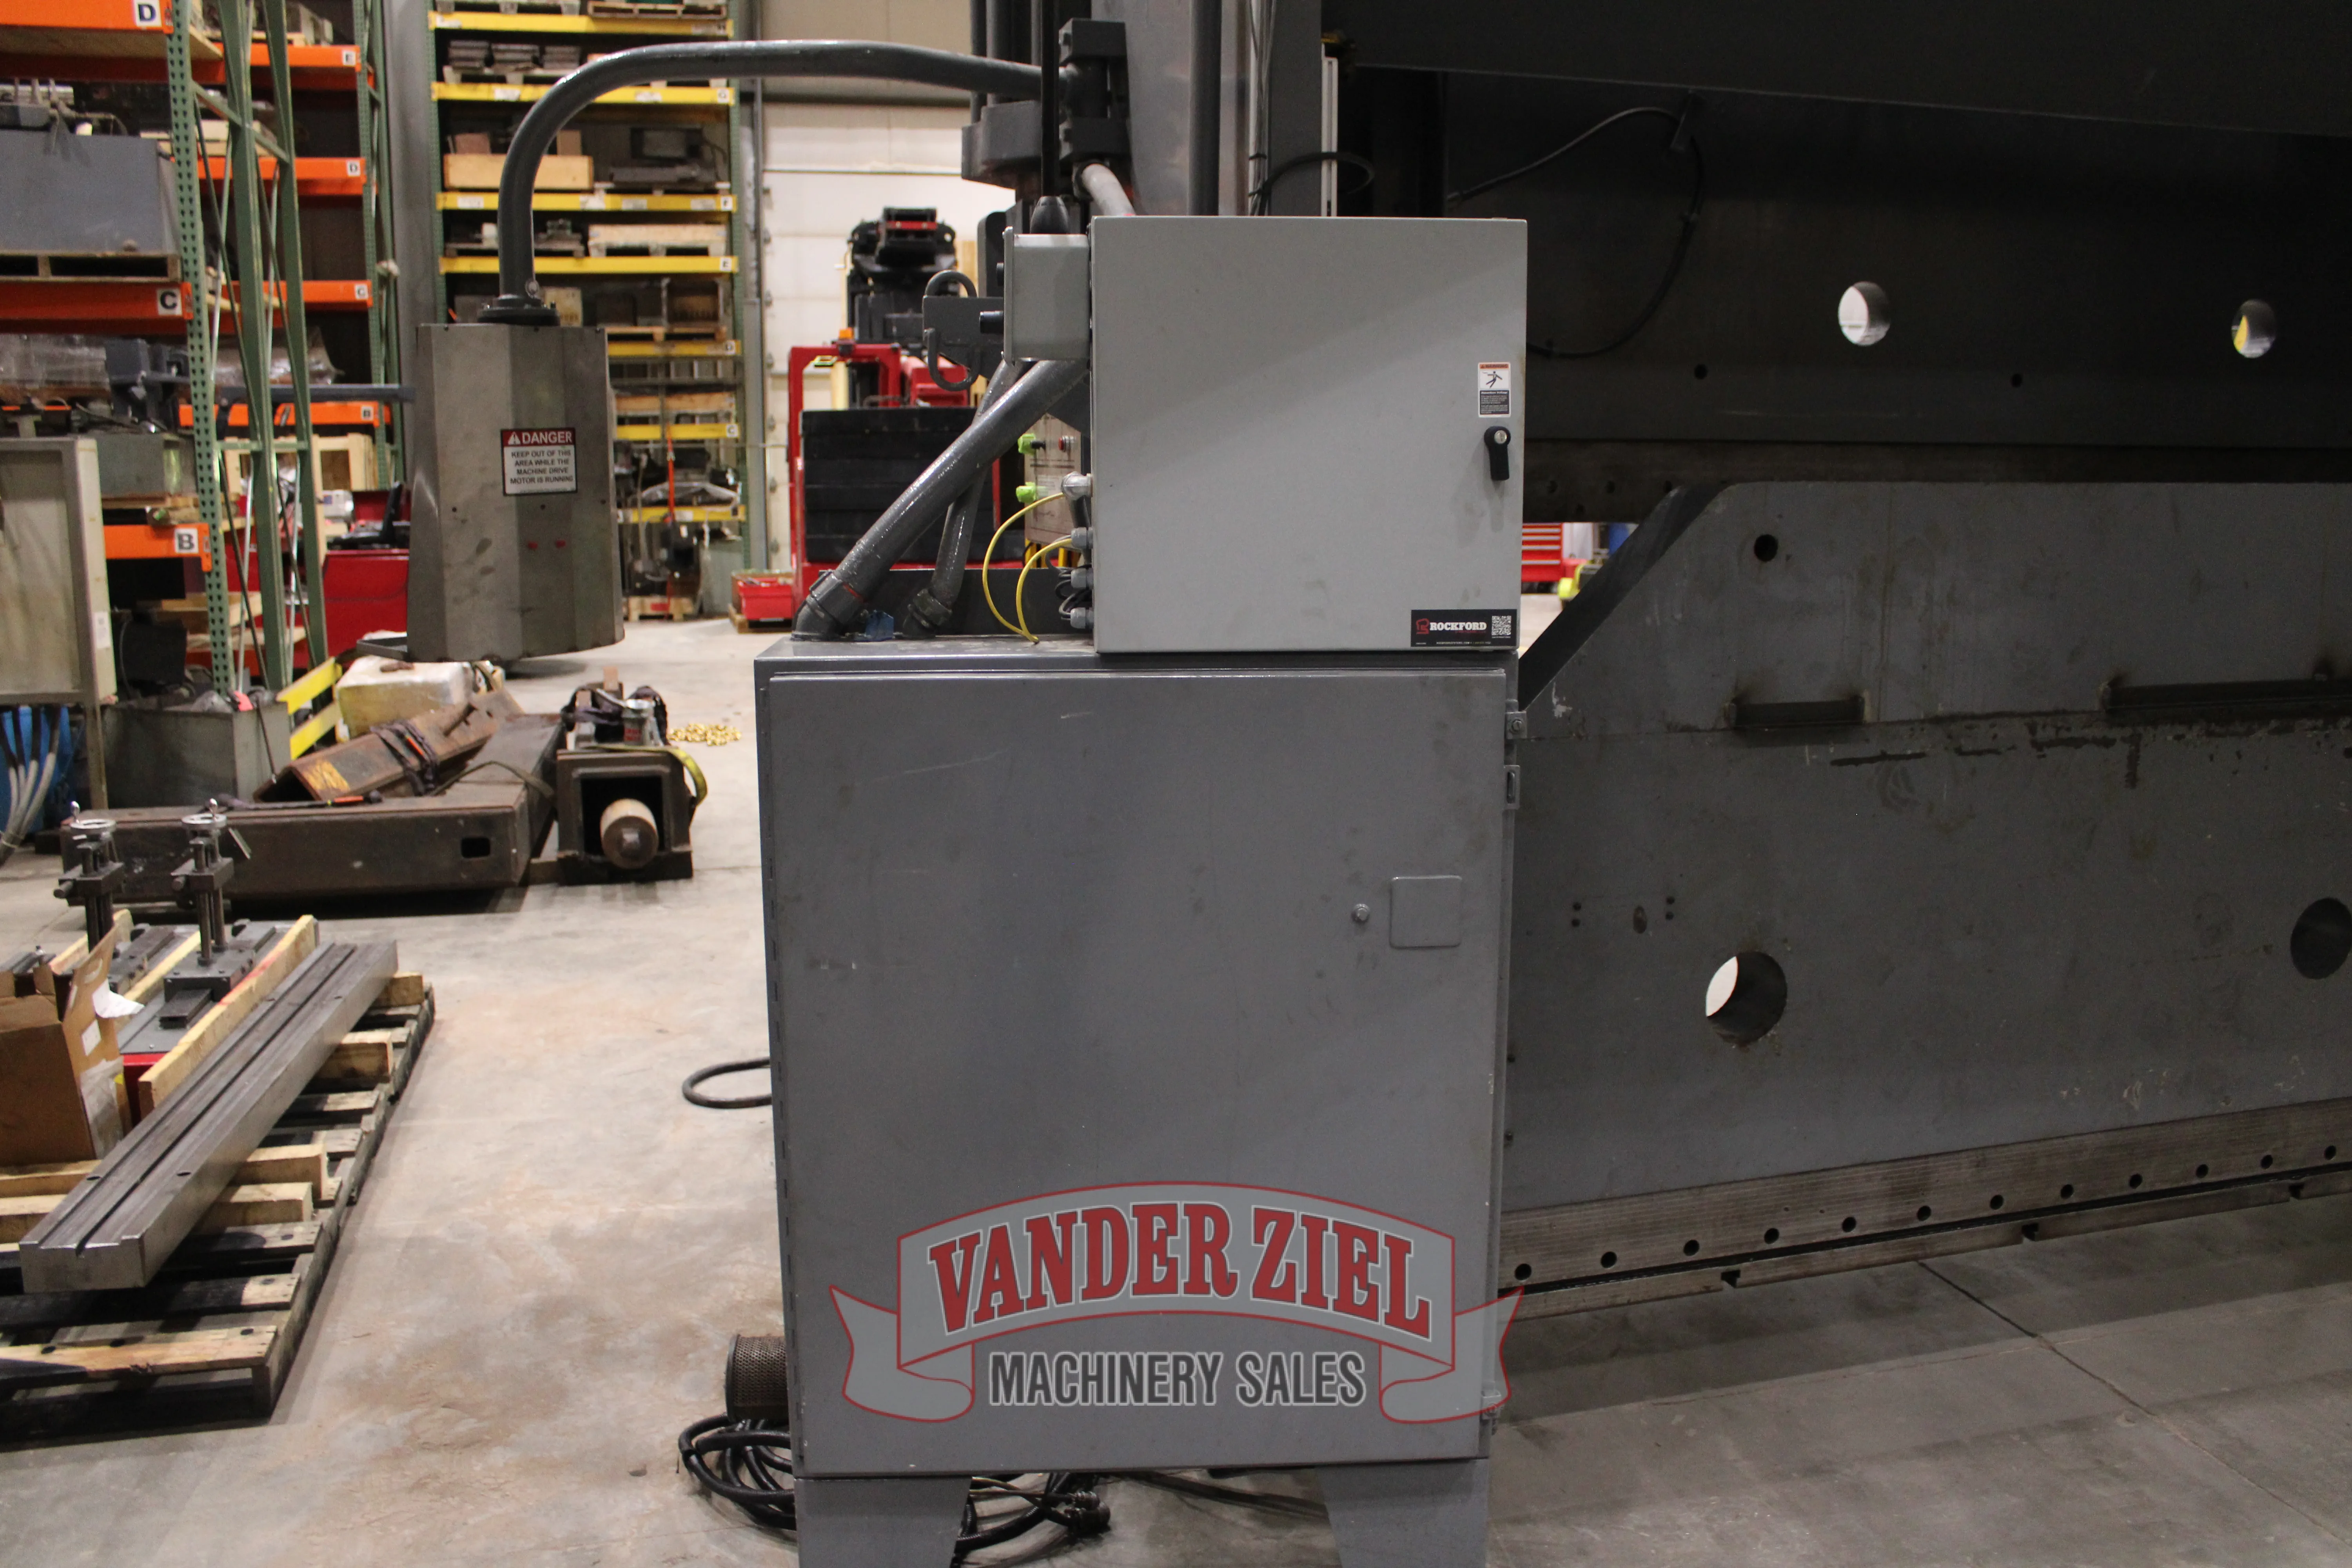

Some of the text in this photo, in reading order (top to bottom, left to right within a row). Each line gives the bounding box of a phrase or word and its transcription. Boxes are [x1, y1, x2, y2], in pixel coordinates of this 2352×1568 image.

[138, 4, 156, 22] D
[349, 163, 358, 173] D
[160, 291, 177, 310] C
[727, 425, 735, 434] C
[522, 431, 572, 444] DANGER
[176, 533, 194, 550] B
[1430, 622, 1487, 631] ROCKFORD
